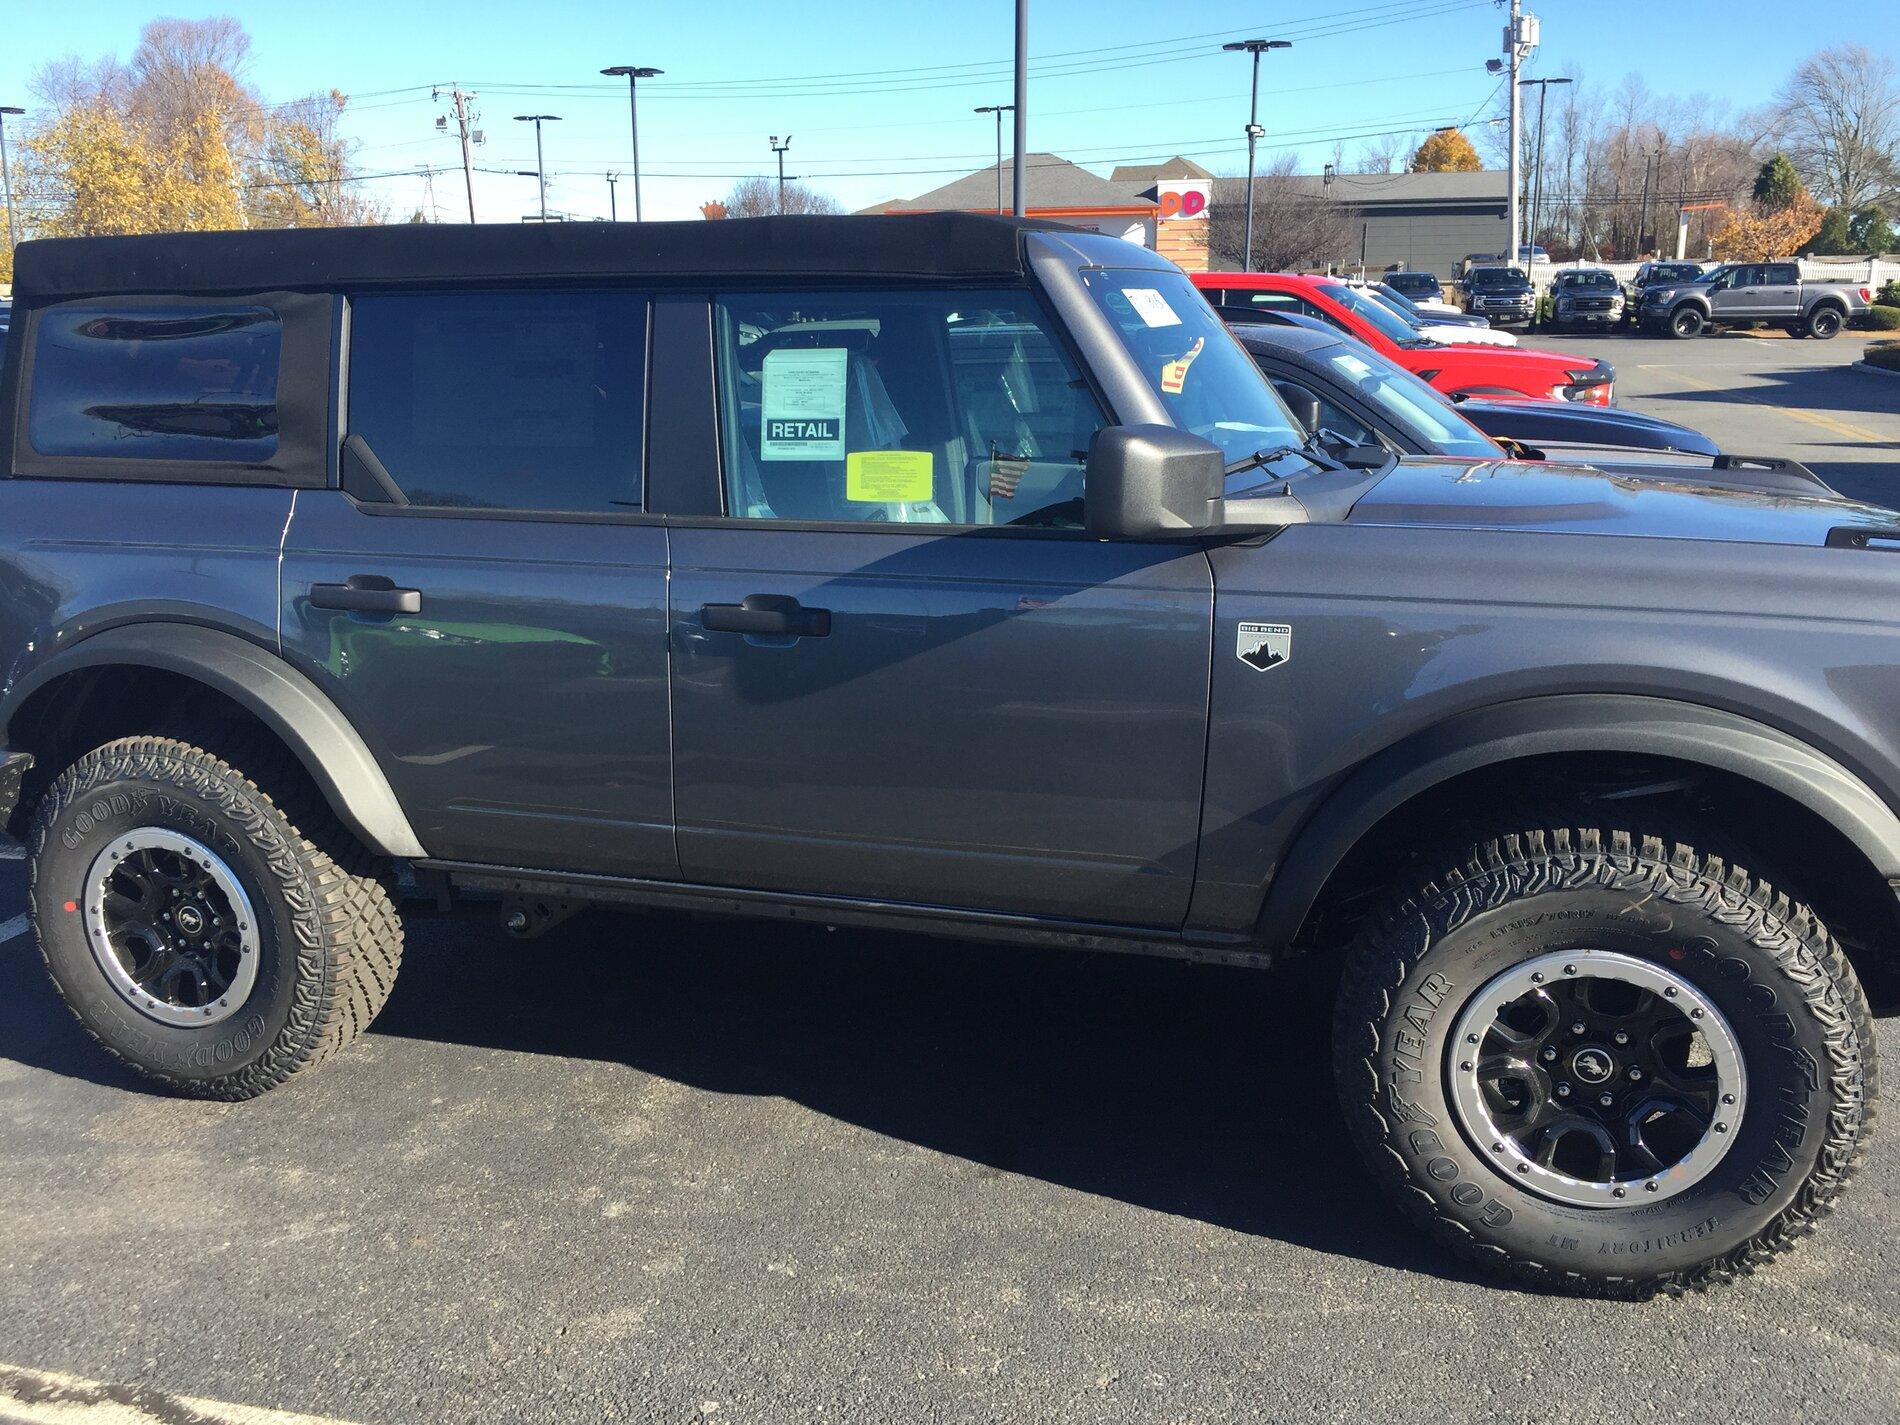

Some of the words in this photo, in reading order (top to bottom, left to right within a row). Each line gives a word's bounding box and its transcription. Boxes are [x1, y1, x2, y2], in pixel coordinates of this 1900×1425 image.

[771, 422, 833, 438] RETAIL
[1545, 1232, 1582, 1251] MT
[1596, 1216, 1723, 1255] TERRITORY
